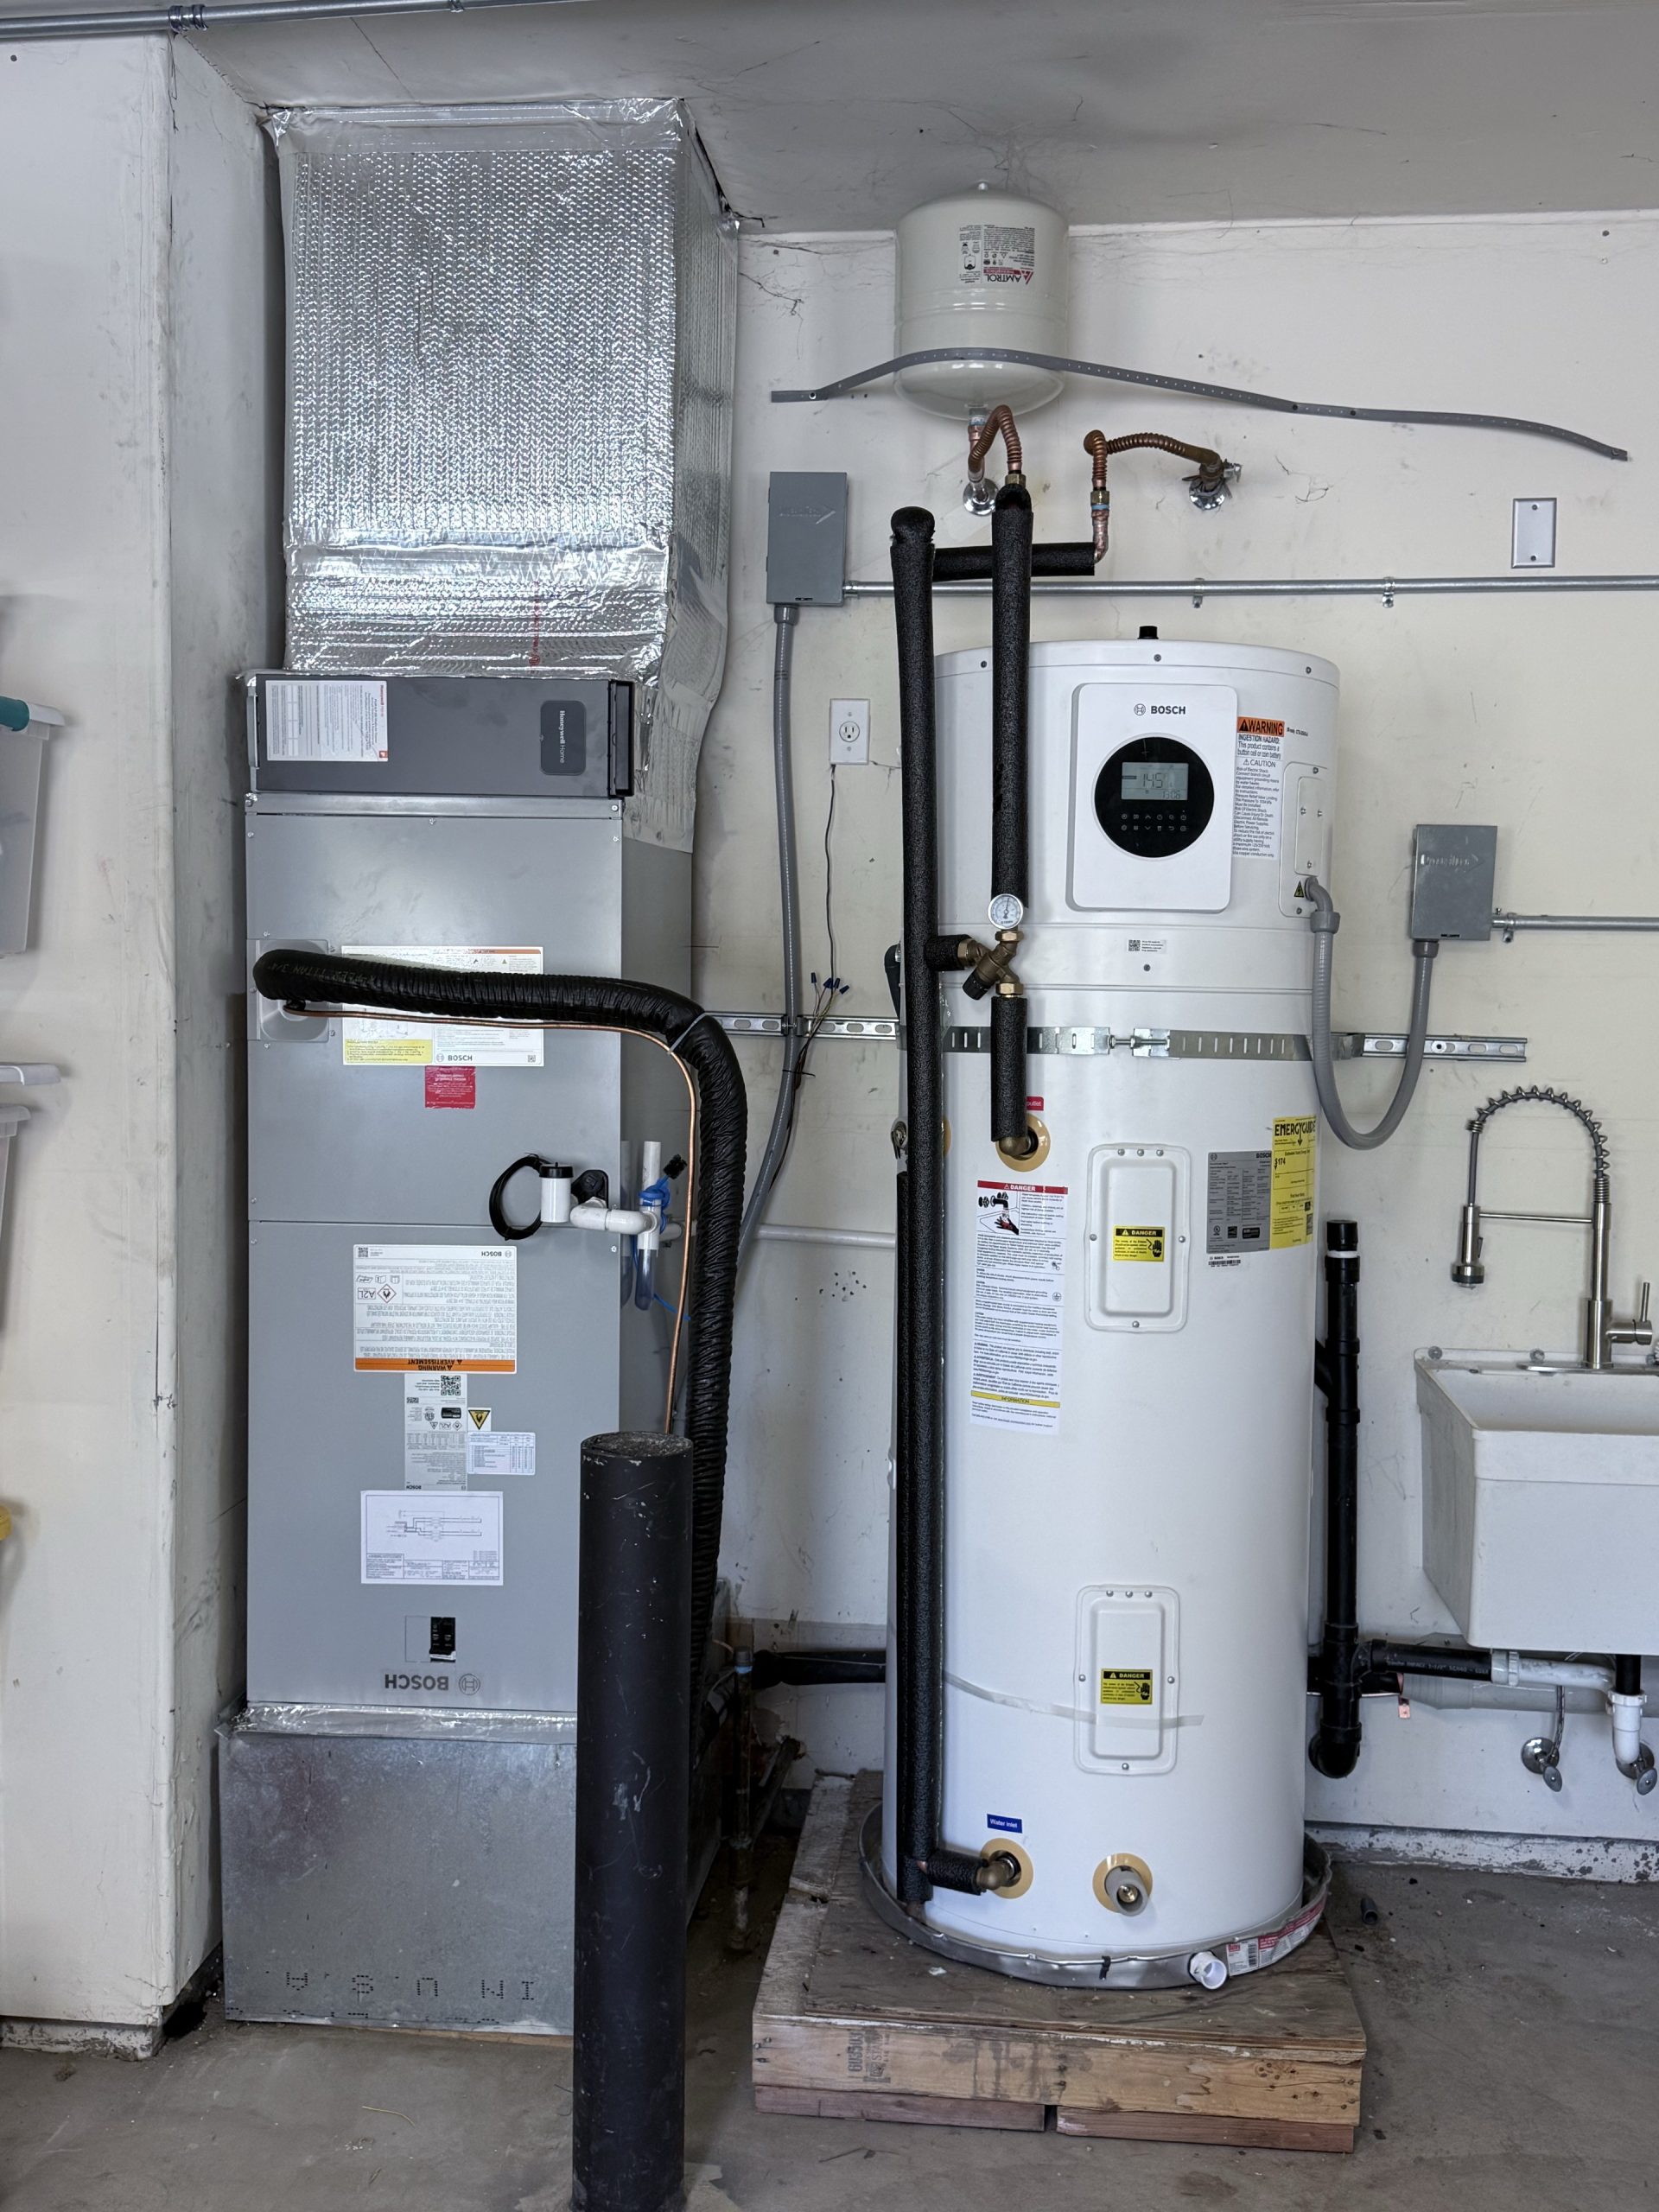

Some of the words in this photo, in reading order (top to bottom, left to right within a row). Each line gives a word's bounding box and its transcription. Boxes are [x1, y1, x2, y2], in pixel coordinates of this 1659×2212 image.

[986, 273, 1022, 283] AMTROL
[1150, 705, 1186, 715] BOSCH
[1248, 720, 1284, 734] WARNING
[1250, 760, 1276, 768] CAUTION
[1143, 773, 1163, 788] 145
[293, 966, 326, 977] TITAN
[358, 1290, 375, 1299] A2L
[385, 1674, 449, 1691] BOSCH
[990, 1818, 1005, 1826] Water
